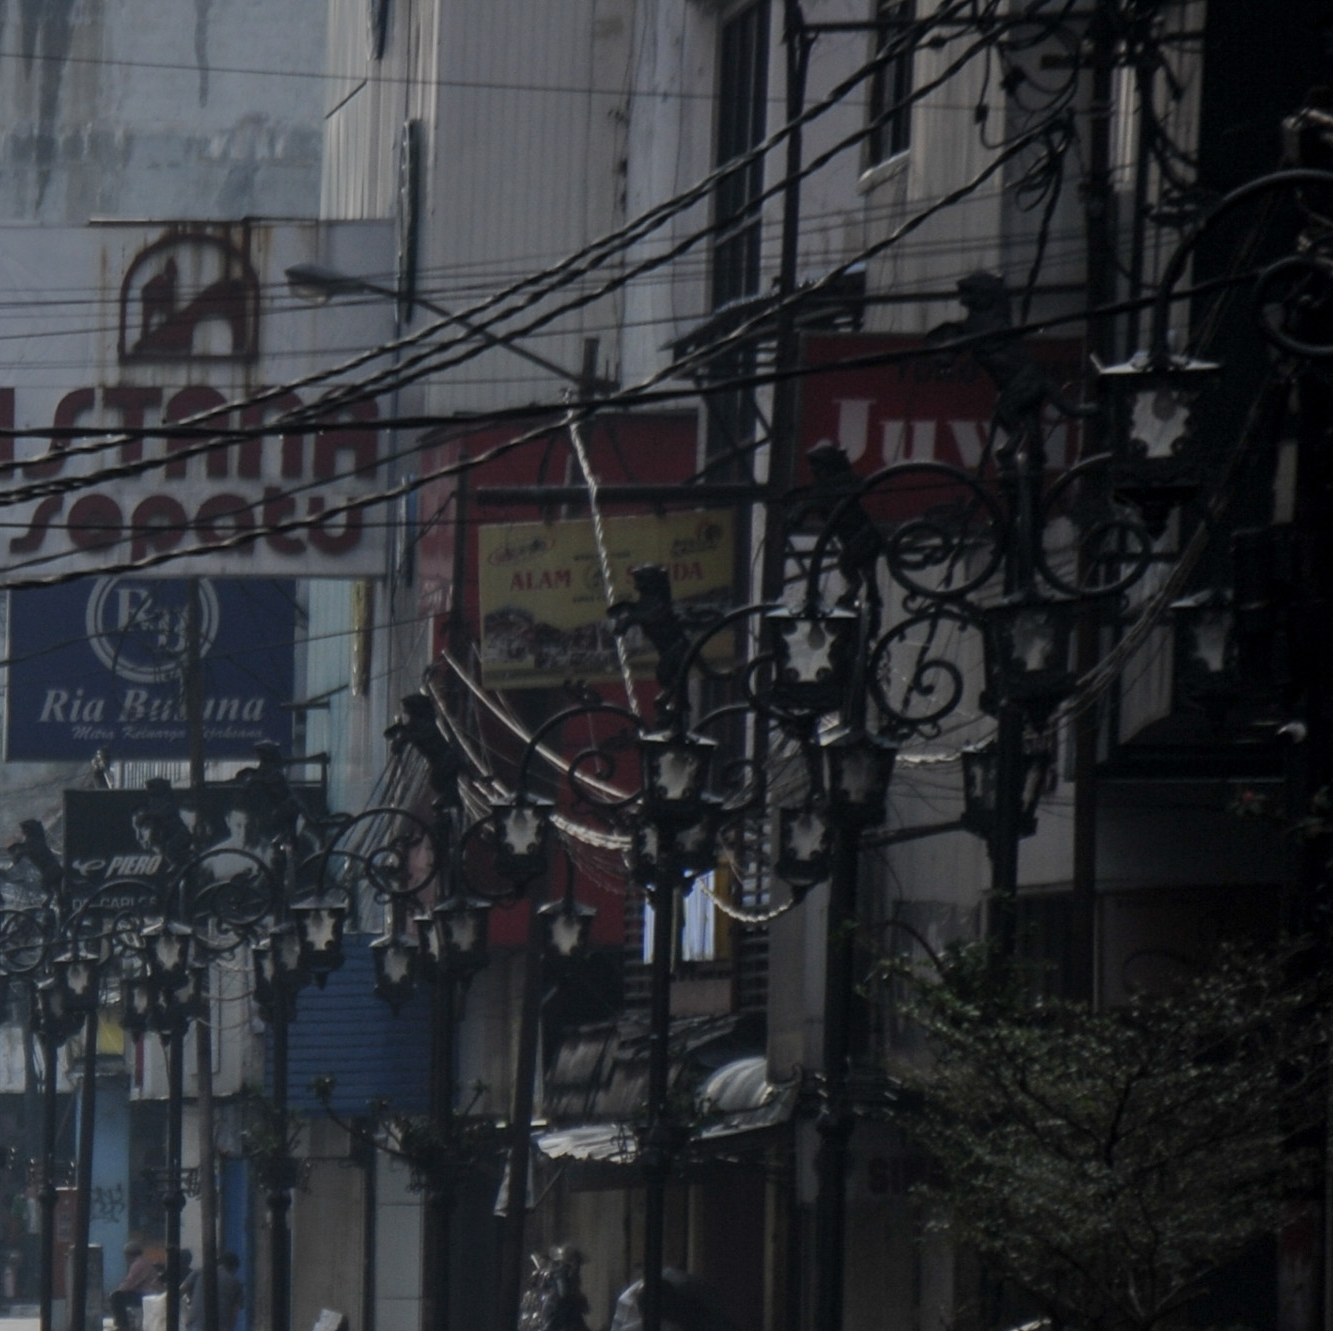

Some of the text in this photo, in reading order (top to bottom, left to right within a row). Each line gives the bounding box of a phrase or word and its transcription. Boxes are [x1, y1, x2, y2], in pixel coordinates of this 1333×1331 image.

[510, 561, 704, 593] ALAM SDA
[37, 688, 105, 722] Ria
[104, 855, 163, 879] PIERO
